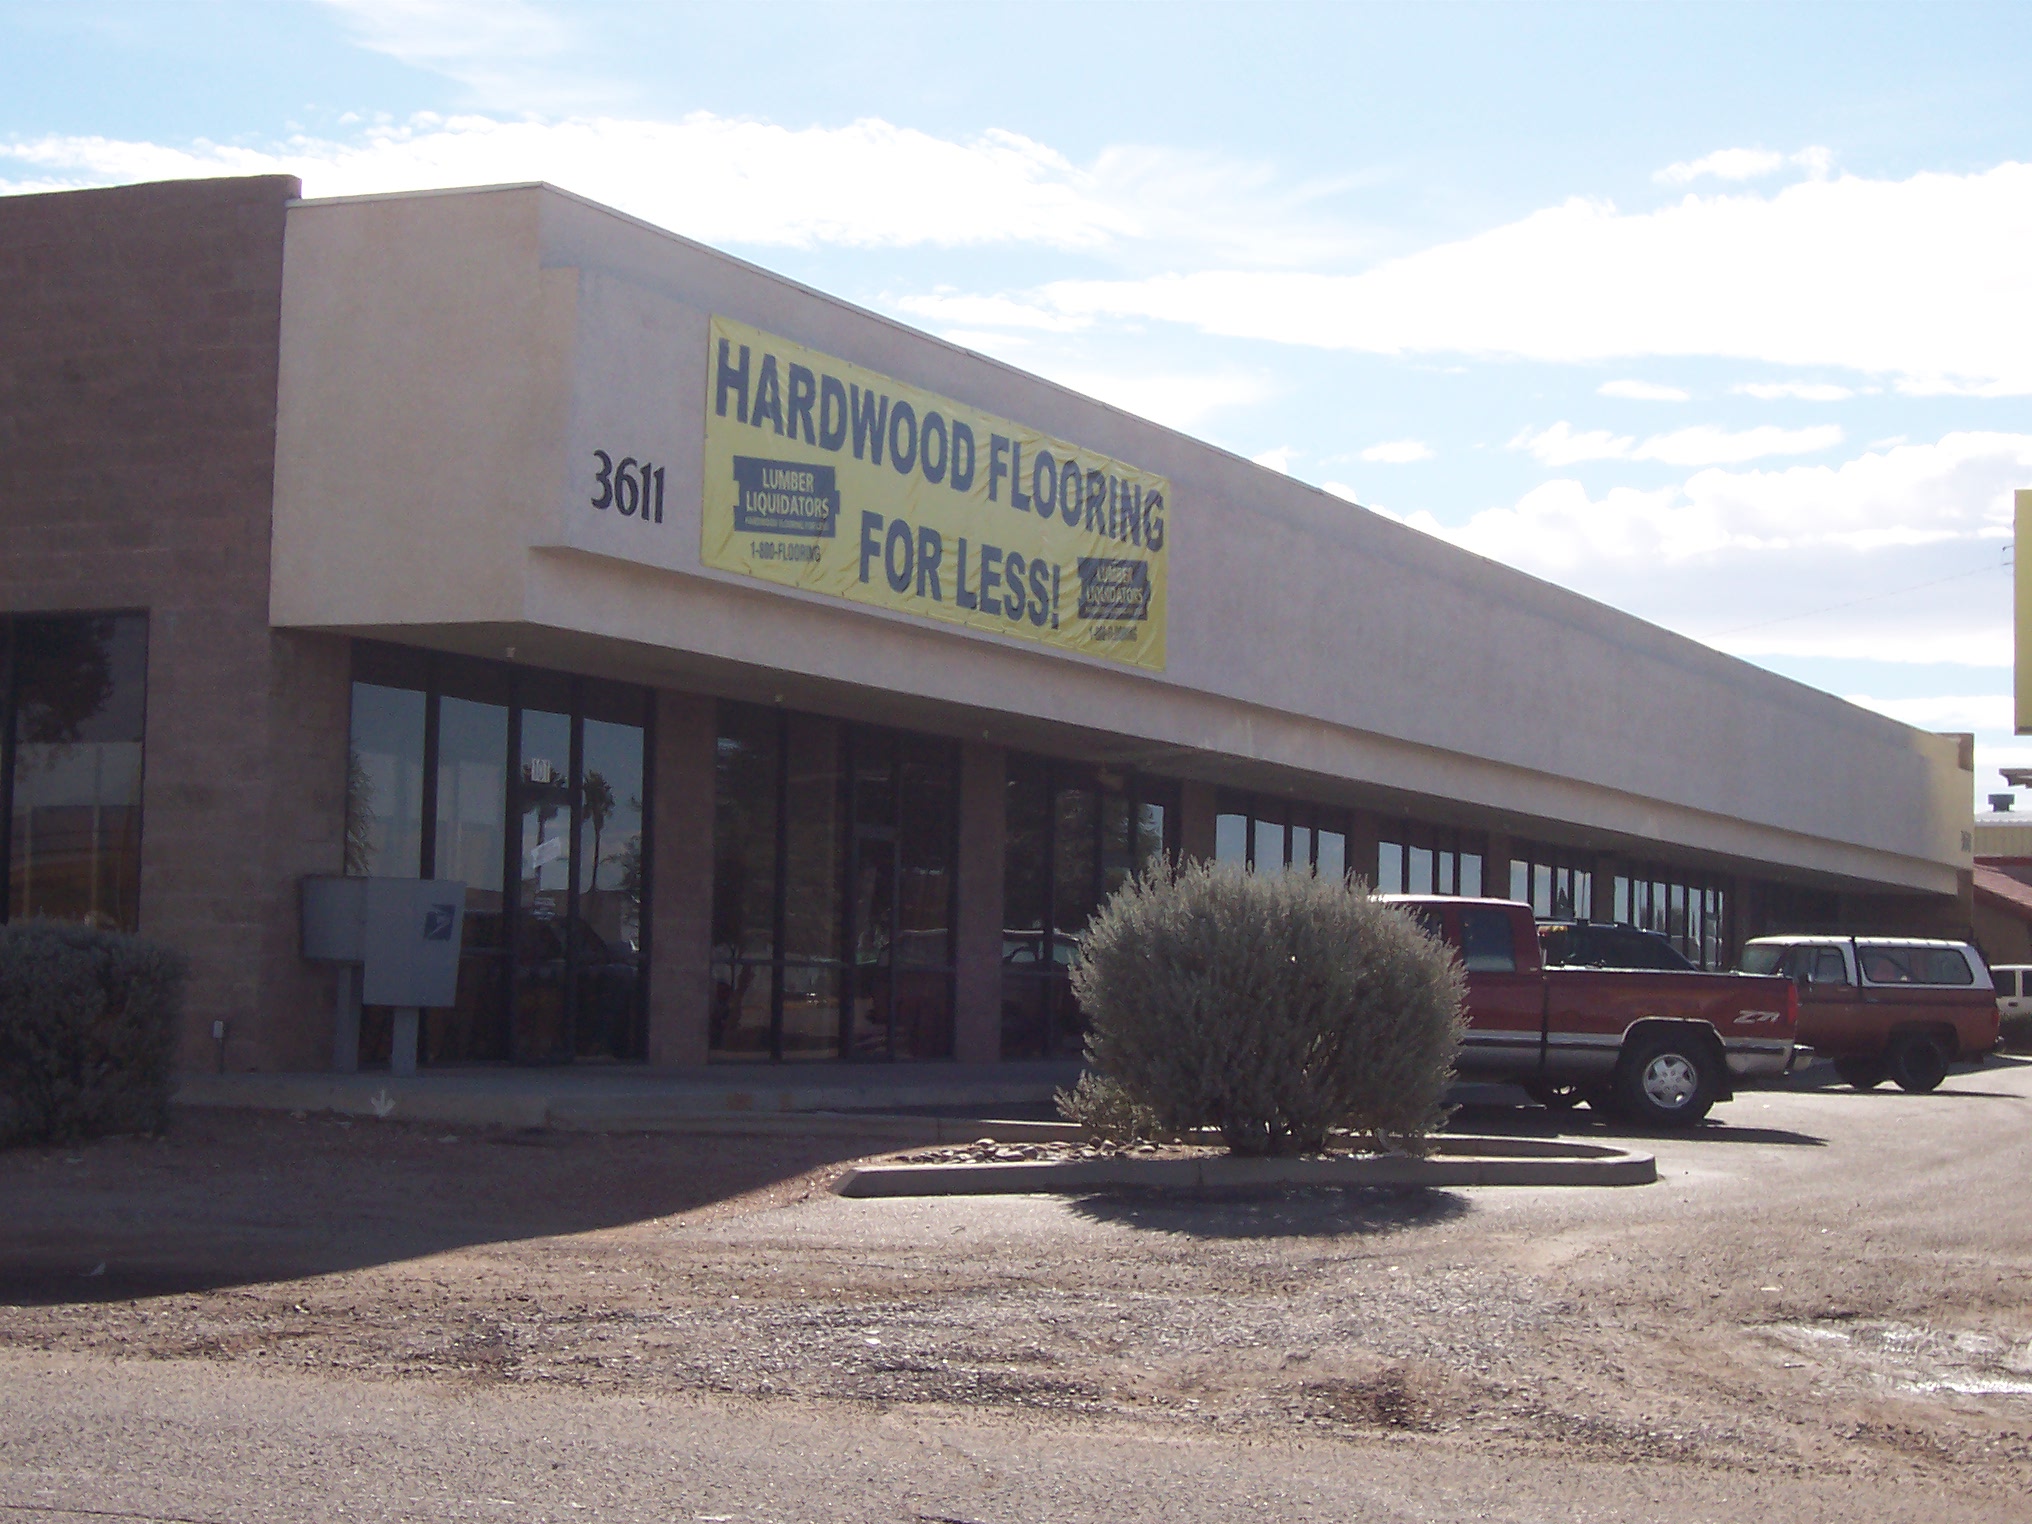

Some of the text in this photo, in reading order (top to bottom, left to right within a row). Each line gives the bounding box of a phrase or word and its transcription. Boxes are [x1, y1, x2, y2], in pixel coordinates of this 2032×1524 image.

[715, 337, 1165, 552] HARDWOOD FLOORING
[762, 467, 814, 493] LUMBER
[590, 449, 665, 524] 3611
[745, 490, 830, 519] LIQUIDATORS
[858, 509, 1060, 630] FOR LESS!
